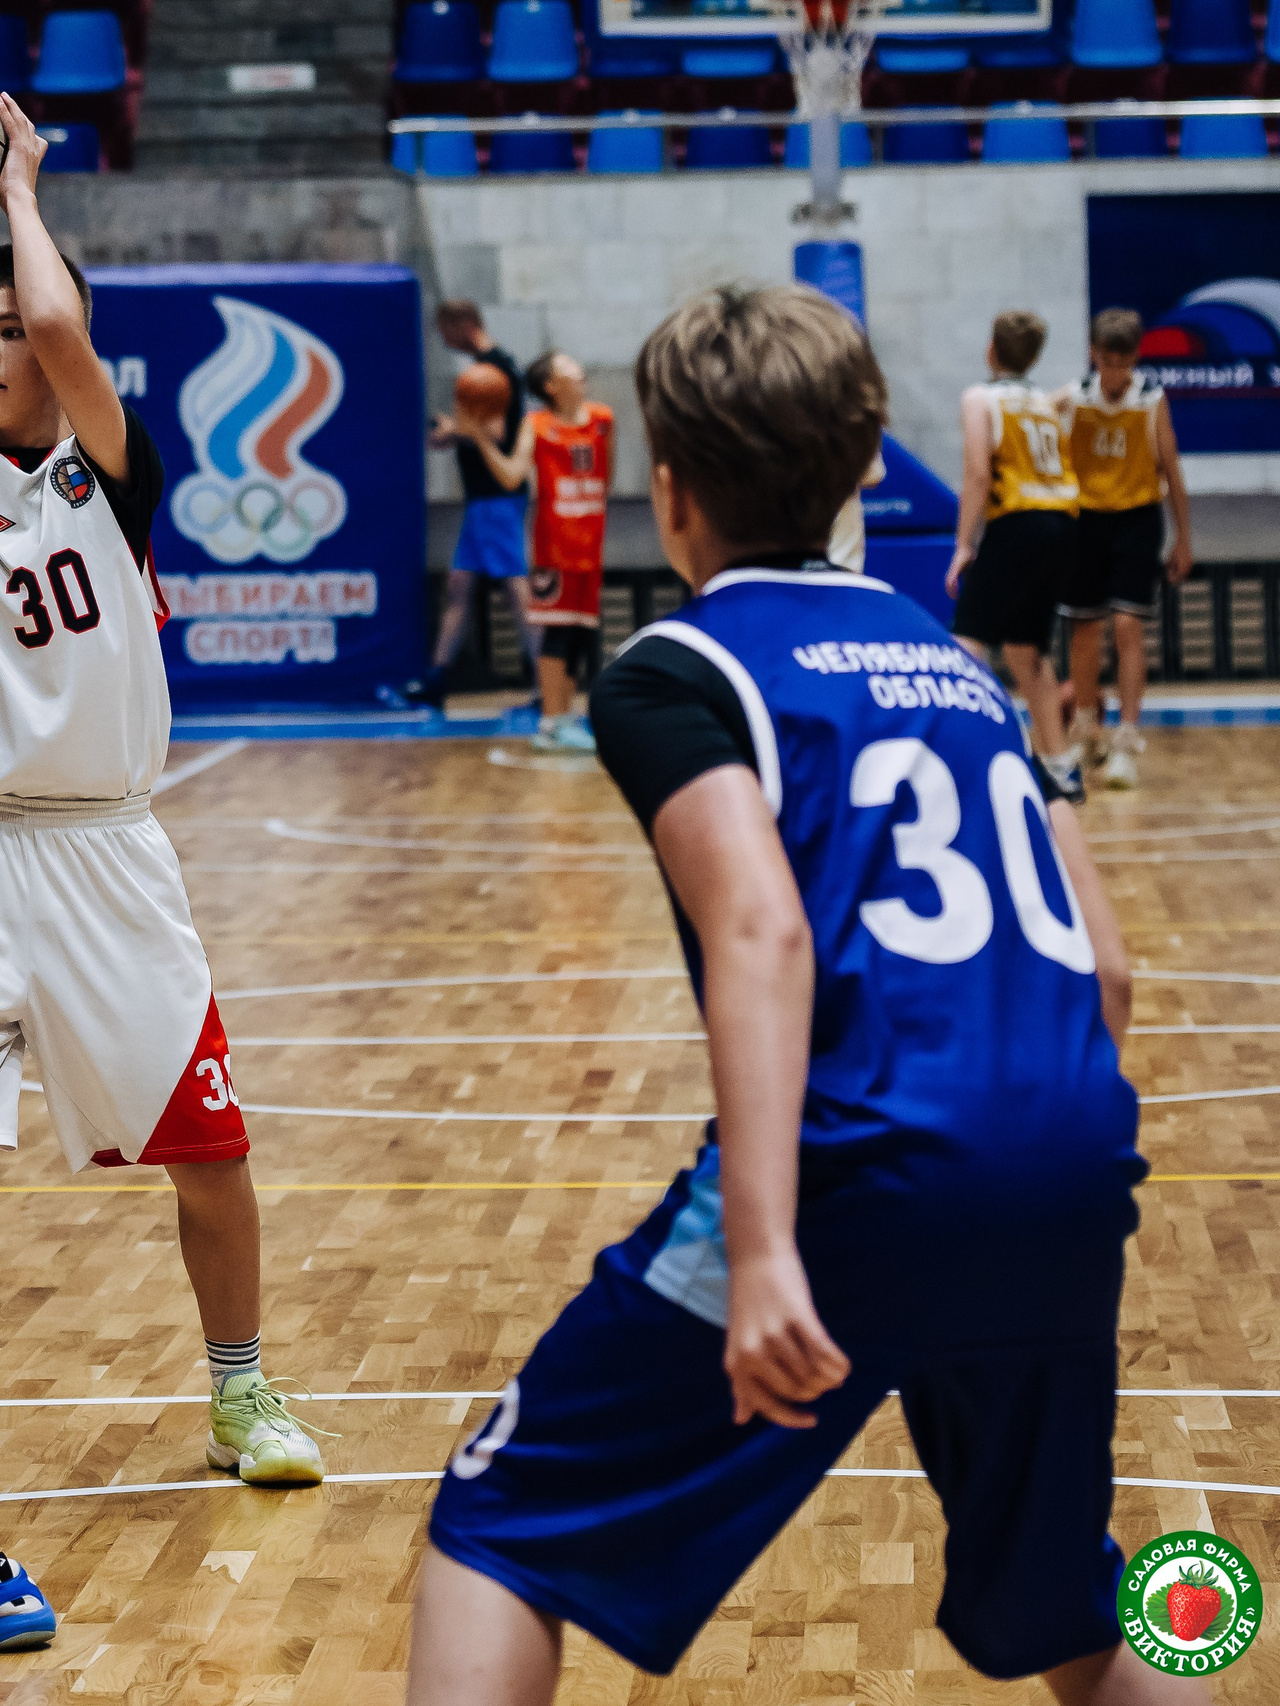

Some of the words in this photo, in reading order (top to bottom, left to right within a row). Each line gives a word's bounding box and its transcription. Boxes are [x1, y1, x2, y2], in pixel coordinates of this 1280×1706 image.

[1020, 418, 1063, 477] 10
[6, 547, 102, 650] 30
[849, 737, 1096, 974] 30
